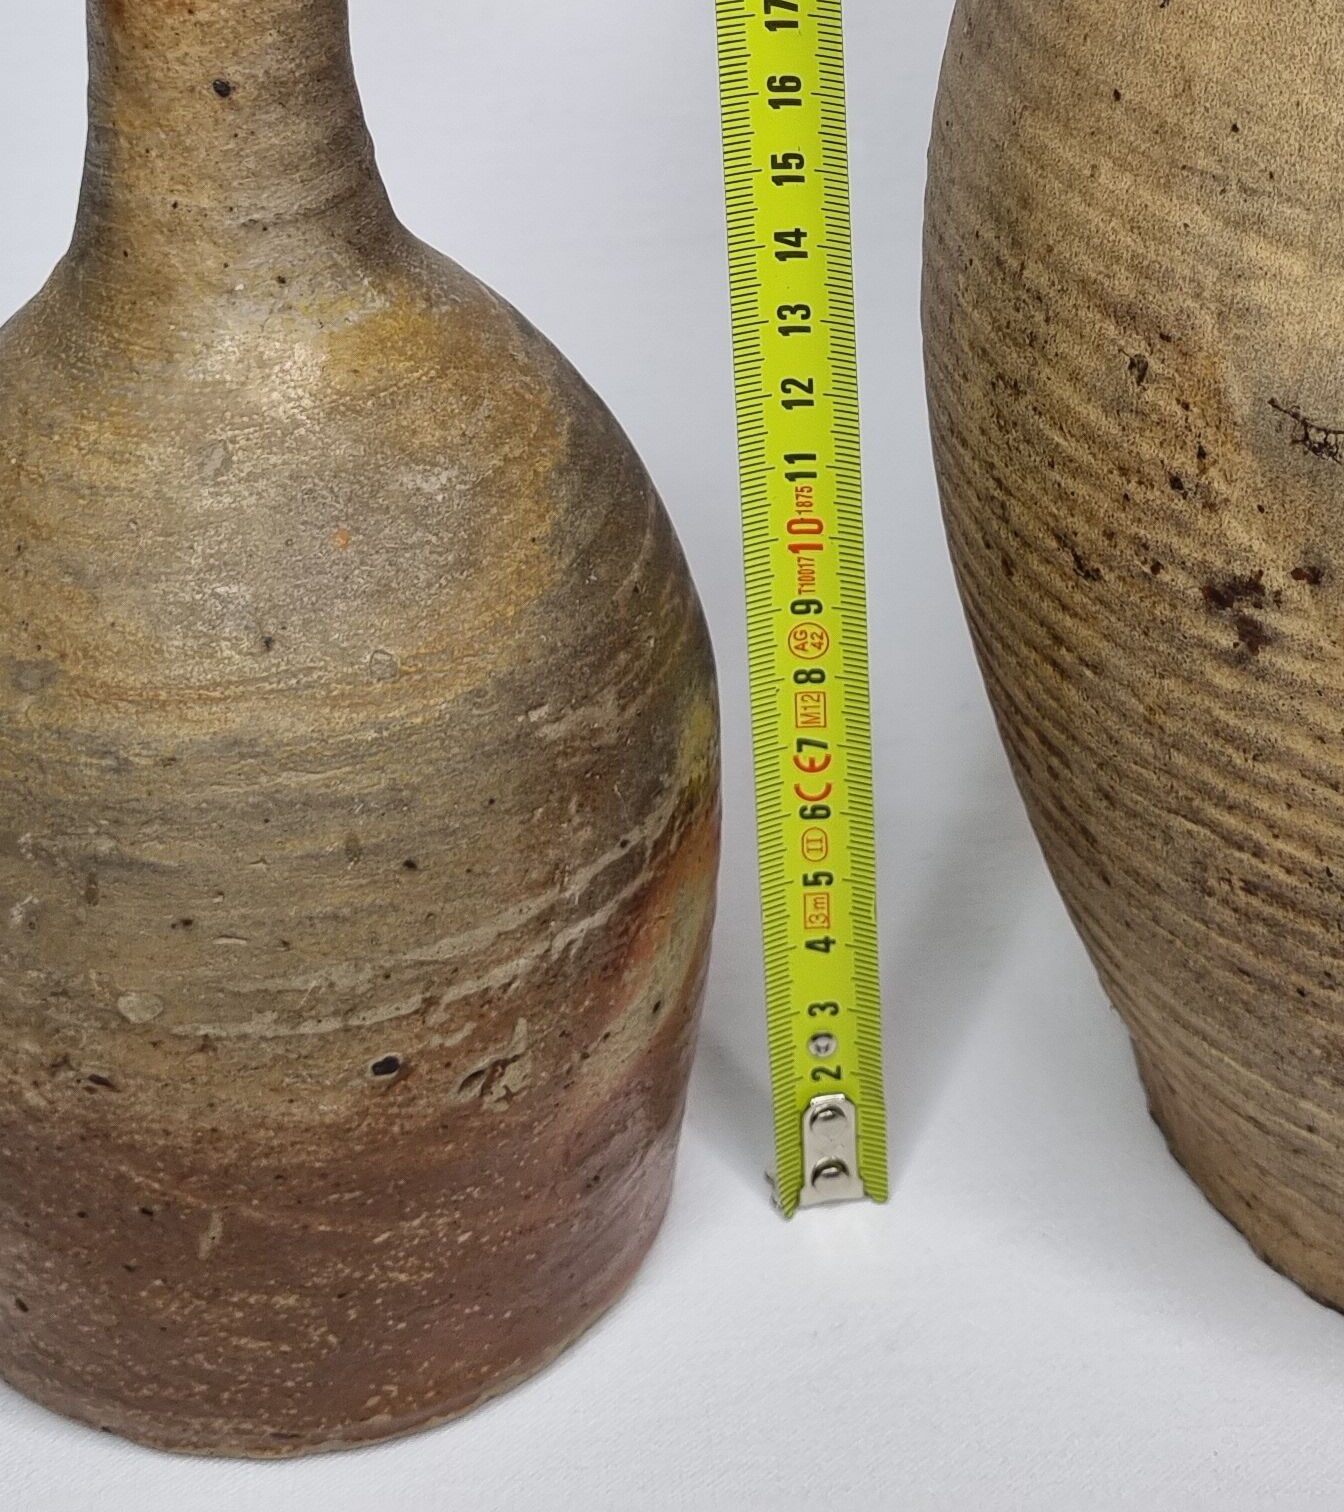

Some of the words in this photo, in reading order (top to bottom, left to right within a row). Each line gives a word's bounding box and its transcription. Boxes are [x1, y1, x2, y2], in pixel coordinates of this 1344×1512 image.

[767, 75, 802, 110] 16
[771, 152, 805, 187] 15
[774, 228, 808, 262] 14
[777, 303, 811, 338] 13
[781, 377, 814, 411] 12
[784, 453, 817, 482] 11
[787, 518, 823, 554] 10
[790, 599, 823, 615] 9
[793, 668, 825, 684] 8
[796, 738, 828, 753] 7
[793, 754, 832, 802] CE
[799, 805, 832, 820] 6
[802, 871, 834, 886] 5
[805, 936, 836, 954] 4
[808, 1001, 840, 1017] 3
[811, 1065, 842, 1081] 2
